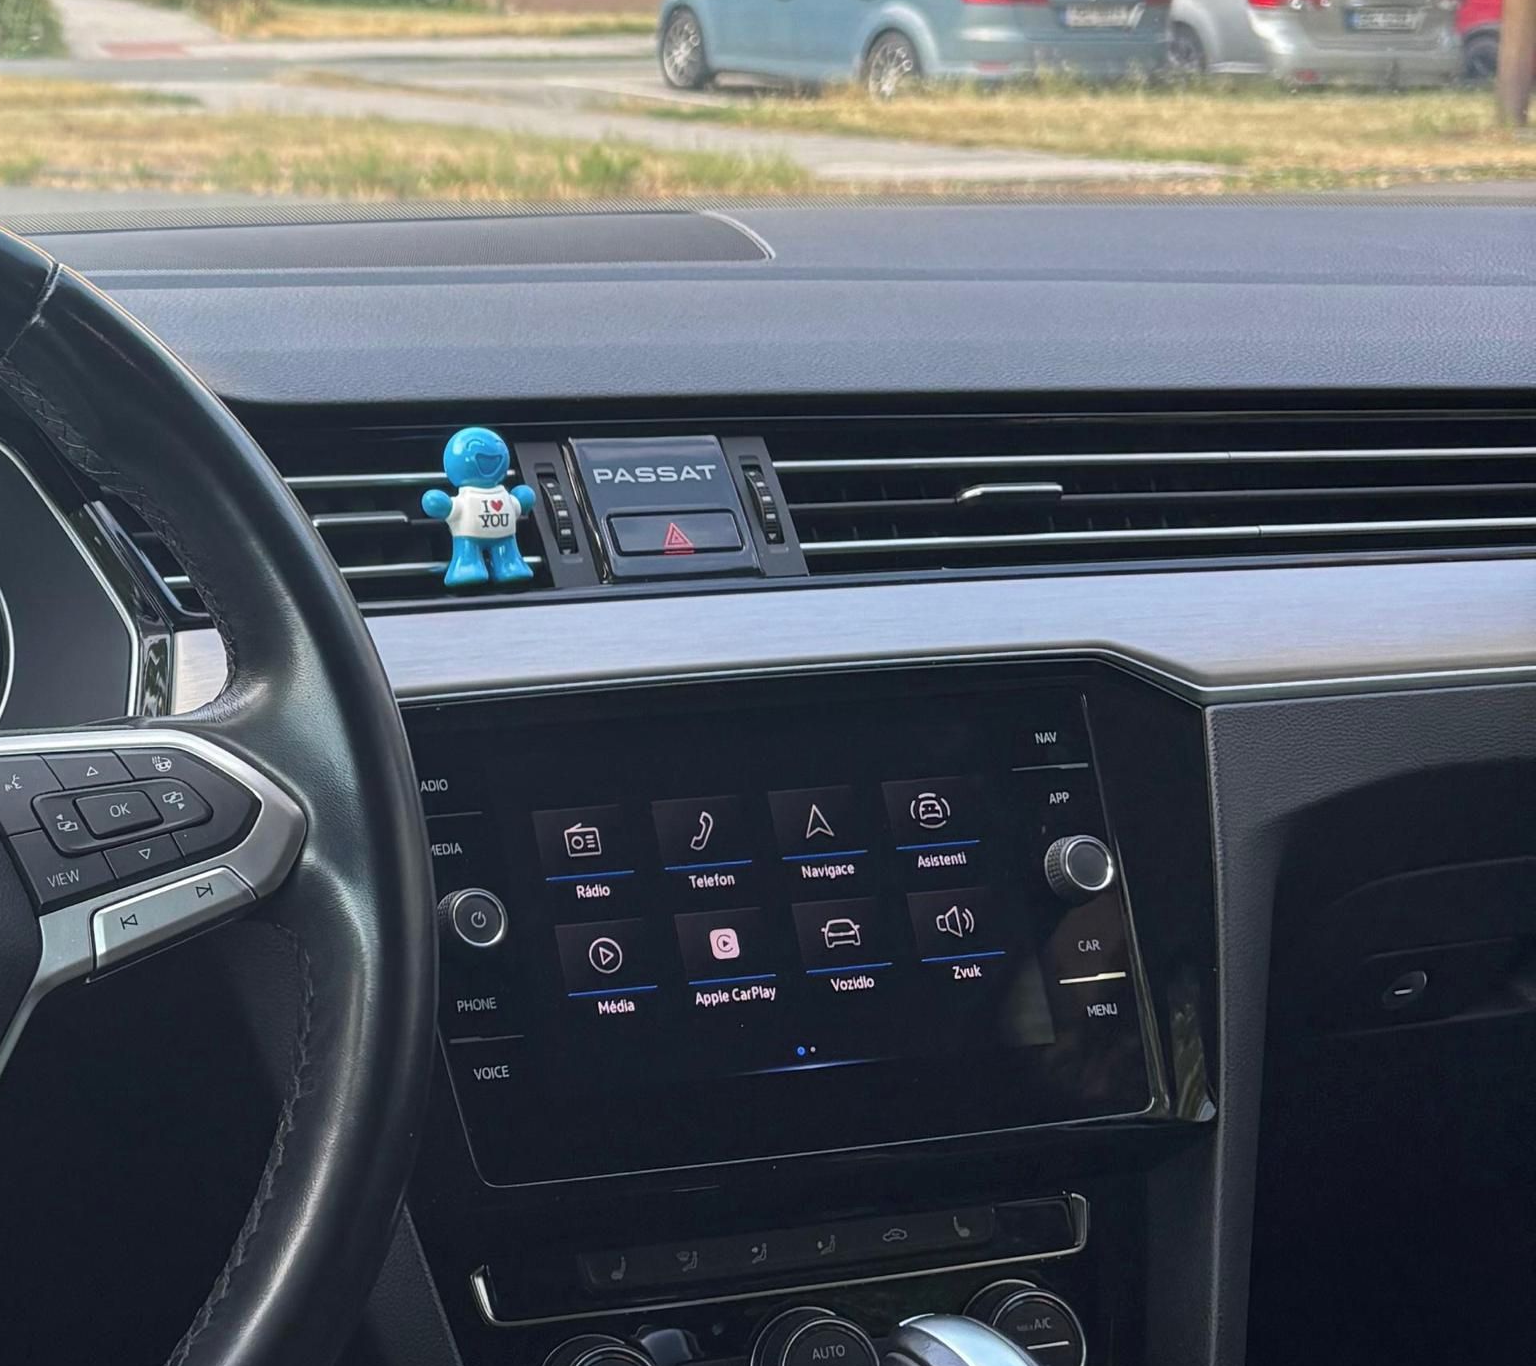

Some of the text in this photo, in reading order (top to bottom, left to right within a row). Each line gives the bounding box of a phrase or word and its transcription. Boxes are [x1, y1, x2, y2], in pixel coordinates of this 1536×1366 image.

[592, 464, 717, 485] PASSAT
[482, 499, 490, 514] I
[477, 513, 510, 529] YOU
[1034, 731, 1057, 744] NAV
[420, 779, 449, 792] ADIO
[1049, 791, 1070, 805] APP
[109, 803, 132, 818] OK
[917, 851, 967, 868] Asistenti
[46, 869, 81, 888] VIEW
[801, 863, 855, 879] Navigace
[689, 873, 735, 889] Telefon
[576, 885, 611, 899] Rádio
[1078, 939, 1101, 952] CAR
[952, 964, 983, 980] Zvuk
[830, 976, 875, 992] Vozidlo
[695, 985, 777, 1007] Apple CarPlay
[456, 997, 498, 1013] PHONE
[597, 999, 635, 1015] Média
[1086, 1003, 1118, 1017] MENU
[473, 1065, 510, 1081] VOICE
[812, 1344, 846, 1360] AUTO
